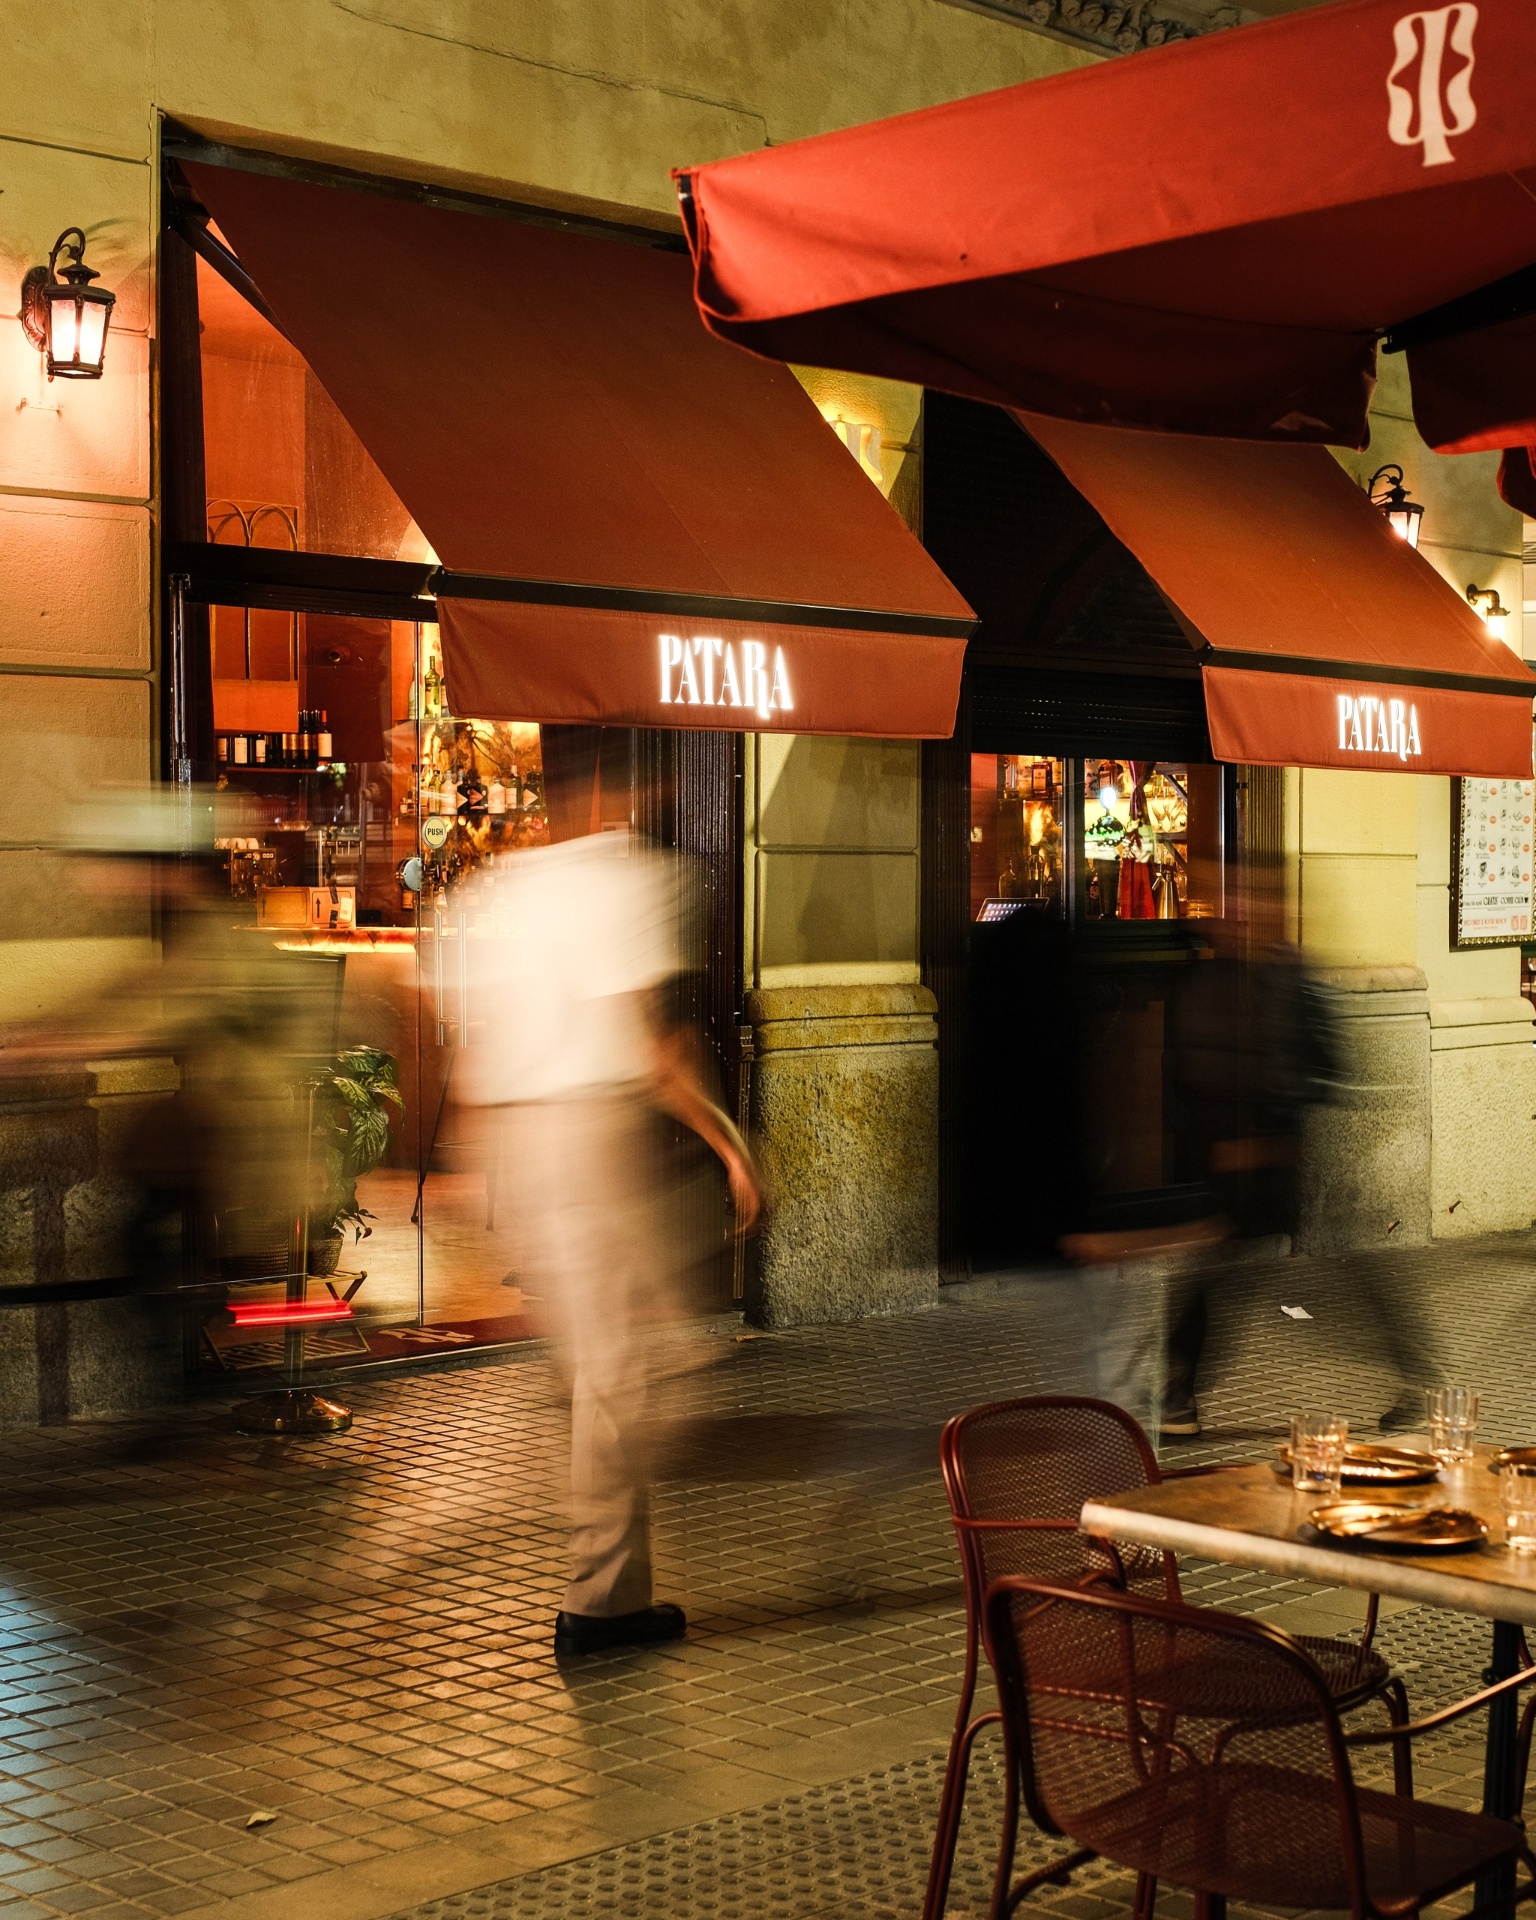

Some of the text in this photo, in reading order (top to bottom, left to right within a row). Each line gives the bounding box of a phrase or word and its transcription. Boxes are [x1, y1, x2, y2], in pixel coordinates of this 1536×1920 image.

[658, 634, 794, 720] PATARA
[1337, 694, 1422, 762] PATARA
[427, 827, 444, 836] PUSH
